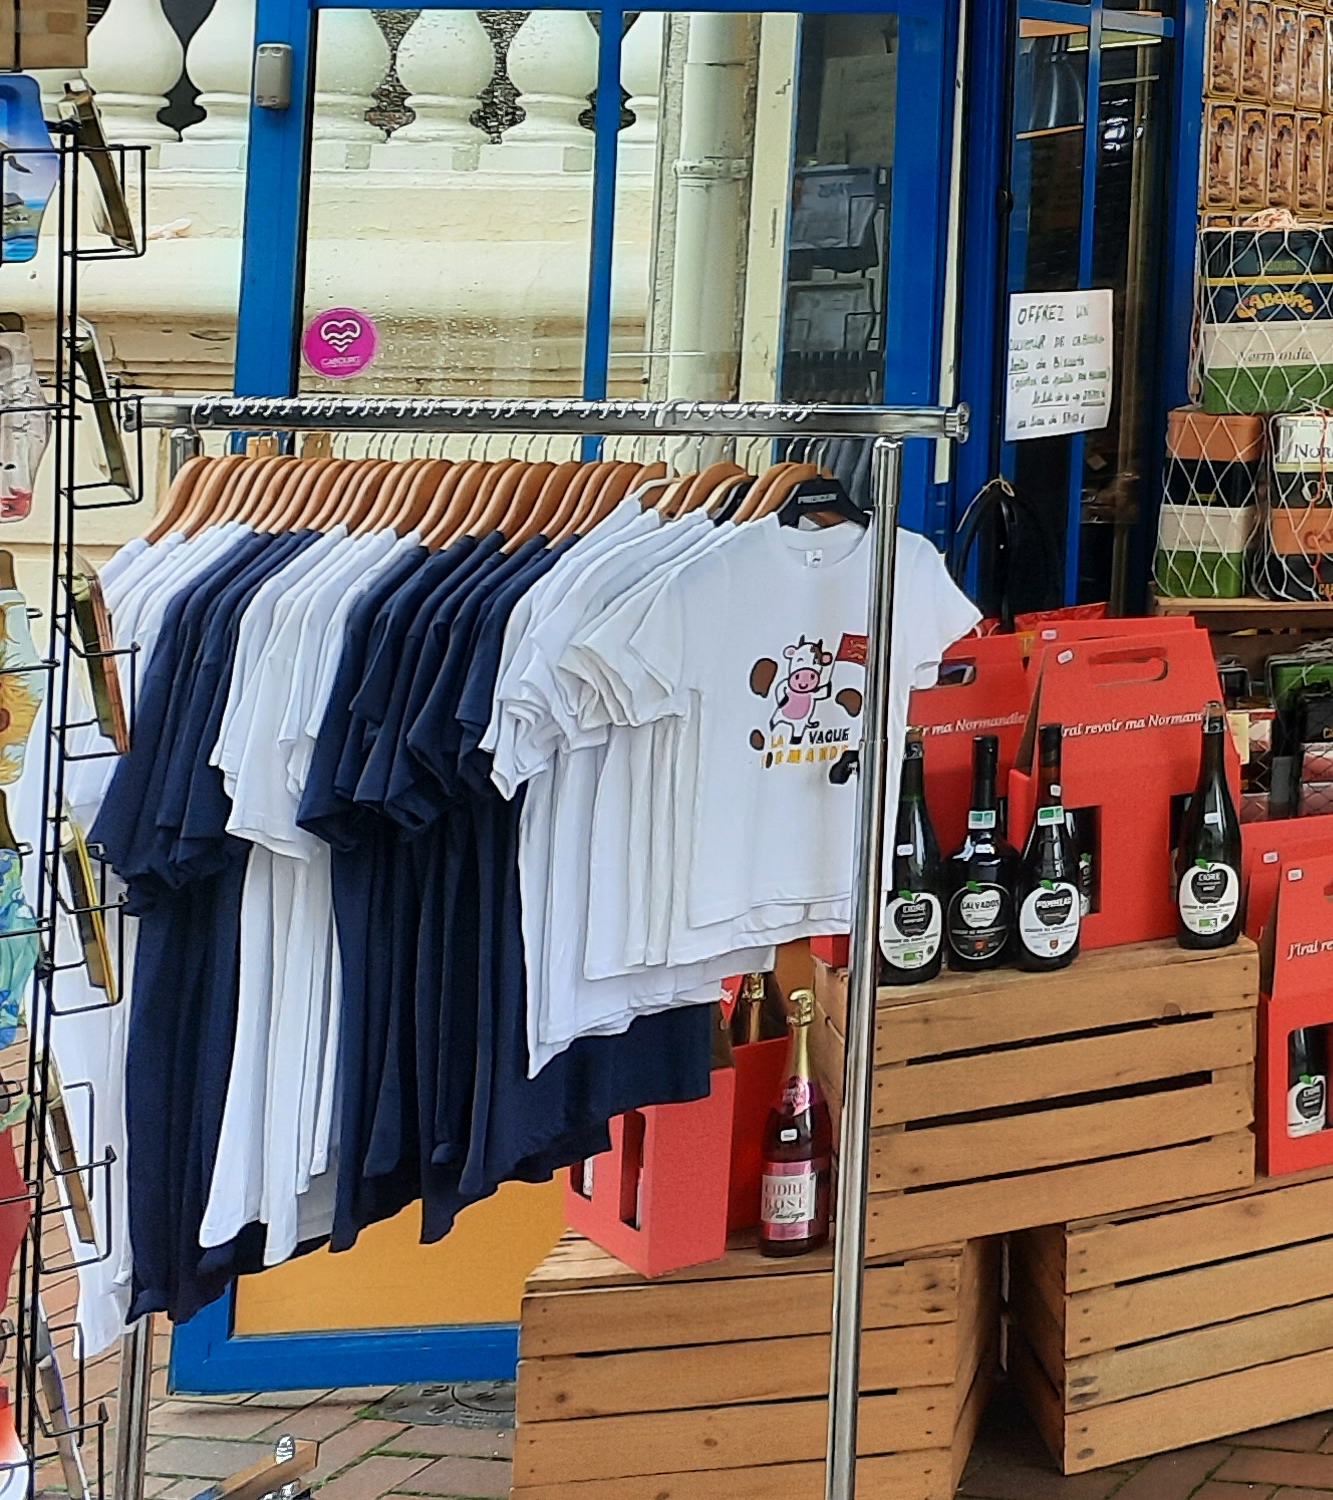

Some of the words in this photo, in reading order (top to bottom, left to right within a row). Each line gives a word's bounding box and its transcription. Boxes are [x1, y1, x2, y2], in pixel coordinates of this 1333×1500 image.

[1017, 304, 1066, 326] OFFREZ
[1236, 290, 1315, 318] CABOURG
[1240, 346, 1312, 362] Normandie
[932, 722, 952, 734] ma
[955, 711, 1026, 732] Normandie
[1085, 718, 1123, 736] revoir
[1125, 716, 1145, 730] ma
[1148, 710, 1204, 726] Normand
[771, 734, 785, 749] LA
[808, 727, 851, 745] VAGUE
[961, 899, 1000, 910] CALVADOS
